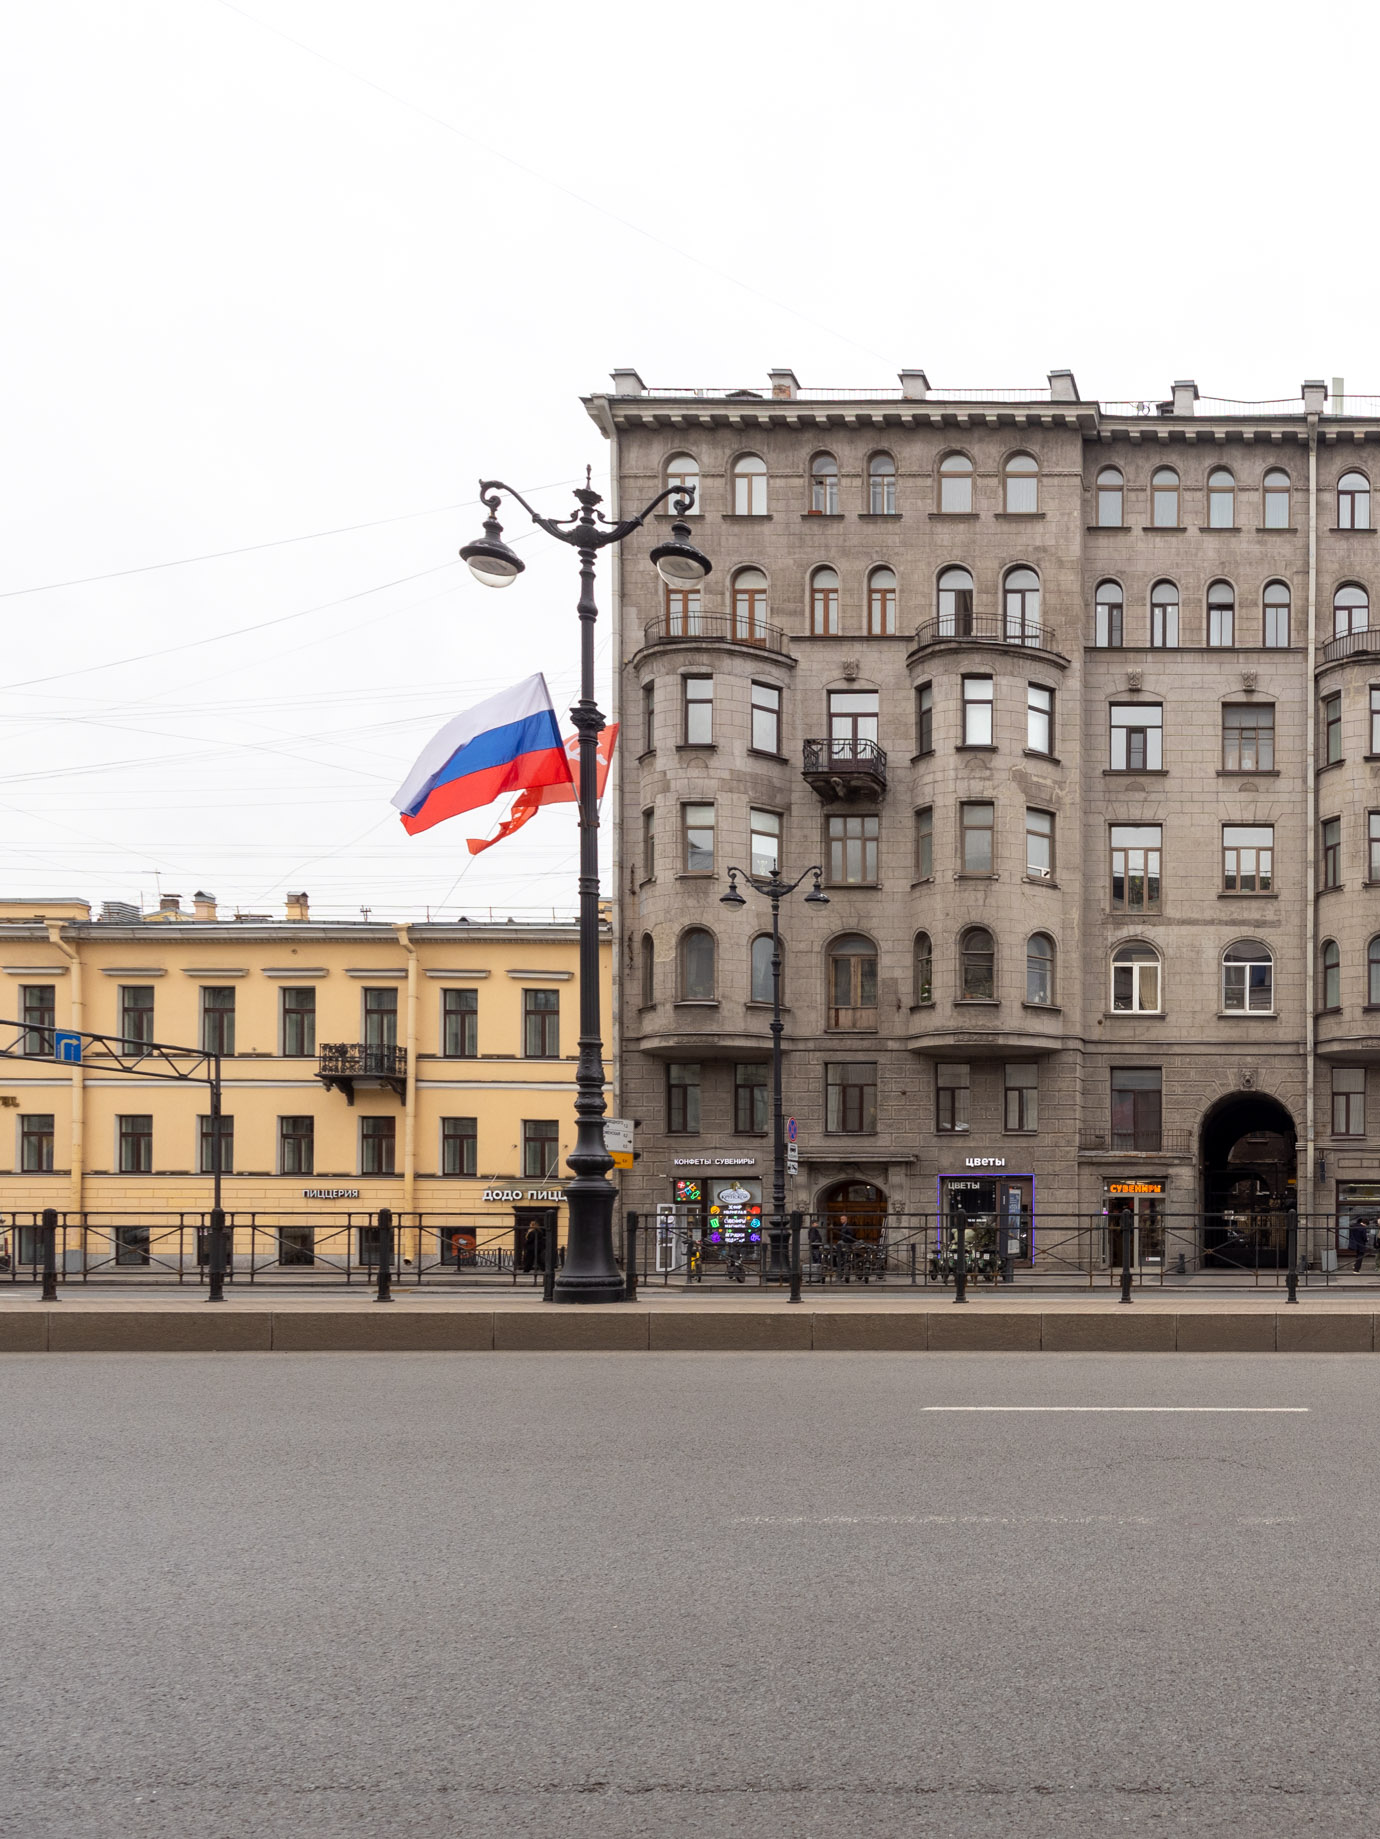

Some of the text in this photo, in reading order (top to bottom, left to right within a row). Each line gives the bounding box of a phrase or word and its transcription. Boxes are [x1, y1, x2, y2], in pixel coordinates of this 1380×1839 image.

[965, 1158, 1005, 1168] цветы
[948, 1181, 980, 1190] ЦВЕТЫ
[1109, 1184, 1162, 1193] СУВЕНИРЫ
[302, 1189, 359, 1199] ПИЦЦЕРИЯ
[482, 1190, 568, 1201] ДОДО ПИЦЦ
